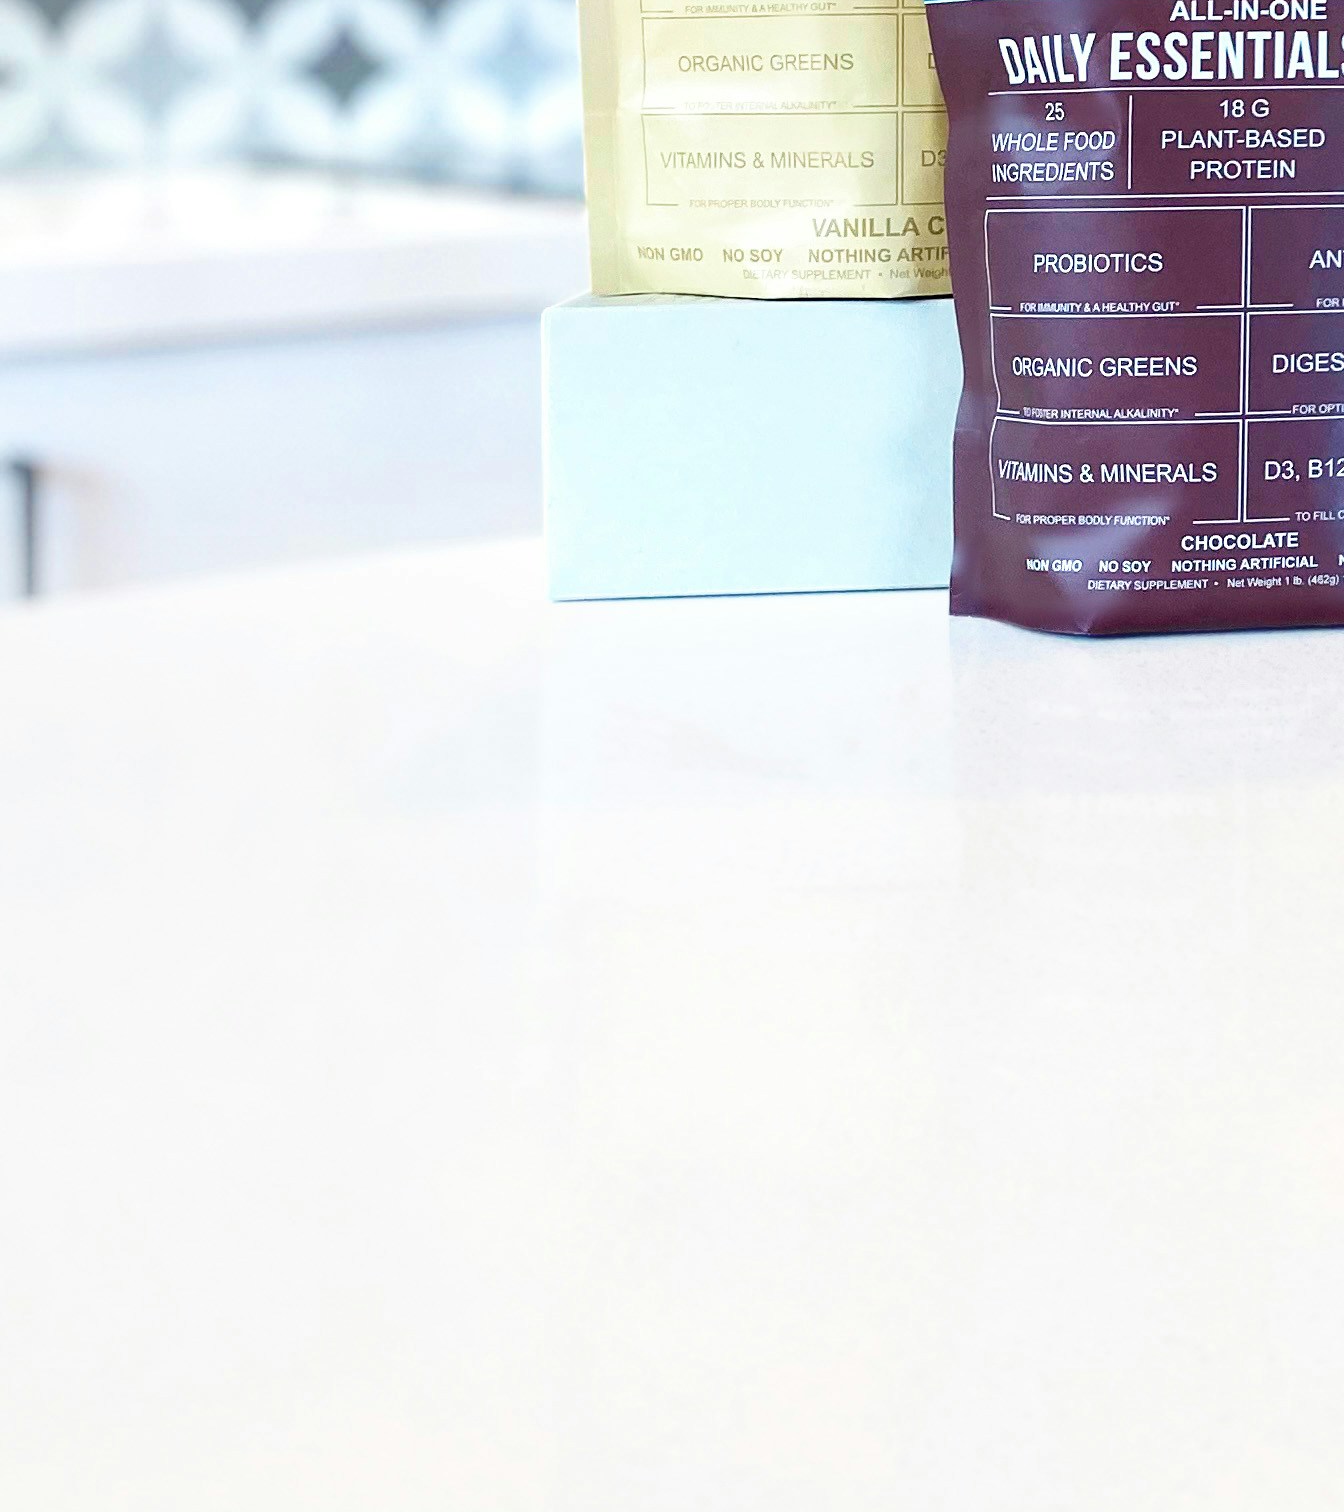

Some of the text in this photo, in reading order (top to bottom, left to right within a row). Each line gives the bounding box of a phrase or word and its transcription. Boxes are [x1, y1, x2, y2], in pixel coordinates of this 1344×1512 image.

[1170, 0, 1327, 21] ALL-IN-ONE
[679, 53, 853, 72] ORGANIC GREENS
[999, 33, 1096, 84] DAILY
[1045, 103, 1064, 120] 25
[1220, 99, 1269, 118] 18 G
[992, 131, 1115, 152] WHOLE FOOD
[1162, 129, 1325, 149] PLANT-BASED
[661, 151, 874, 168] VITAMINS MINERALS
[992, 162, 1114, 182] INGREDIENTS
[1191, 160, 1295, 179] PROTEIN
[813, 217, 920, 237] VANILLA
[1034, 253, 1162, 273] PROBIOTICS
[1102, 302, 1150, 312] HEALTHY
[1317, 298, 1339, 307] FOR
[1013, 357, 1197, 377] ORGANIC GREENS
[1061, 409, 1112, 418] INTERNAL
[999, 459, 1216, 483] VITAMINS & MINERALS
[1265, 461, 1299, 481] D3,
[1033, 515, 1076, 524] PROPER
[1182, 532, 1298, 550] CHOCOLATE
[1052, 560, 1082, 572] GMO
[1099, 561, 1151, 572] NO SOY
[1172, 556, 1318, 572] NOTHING ARTIFICIAL
[1088, 577, 1281, 590] DIETARY SUPPLEMENT Weight
